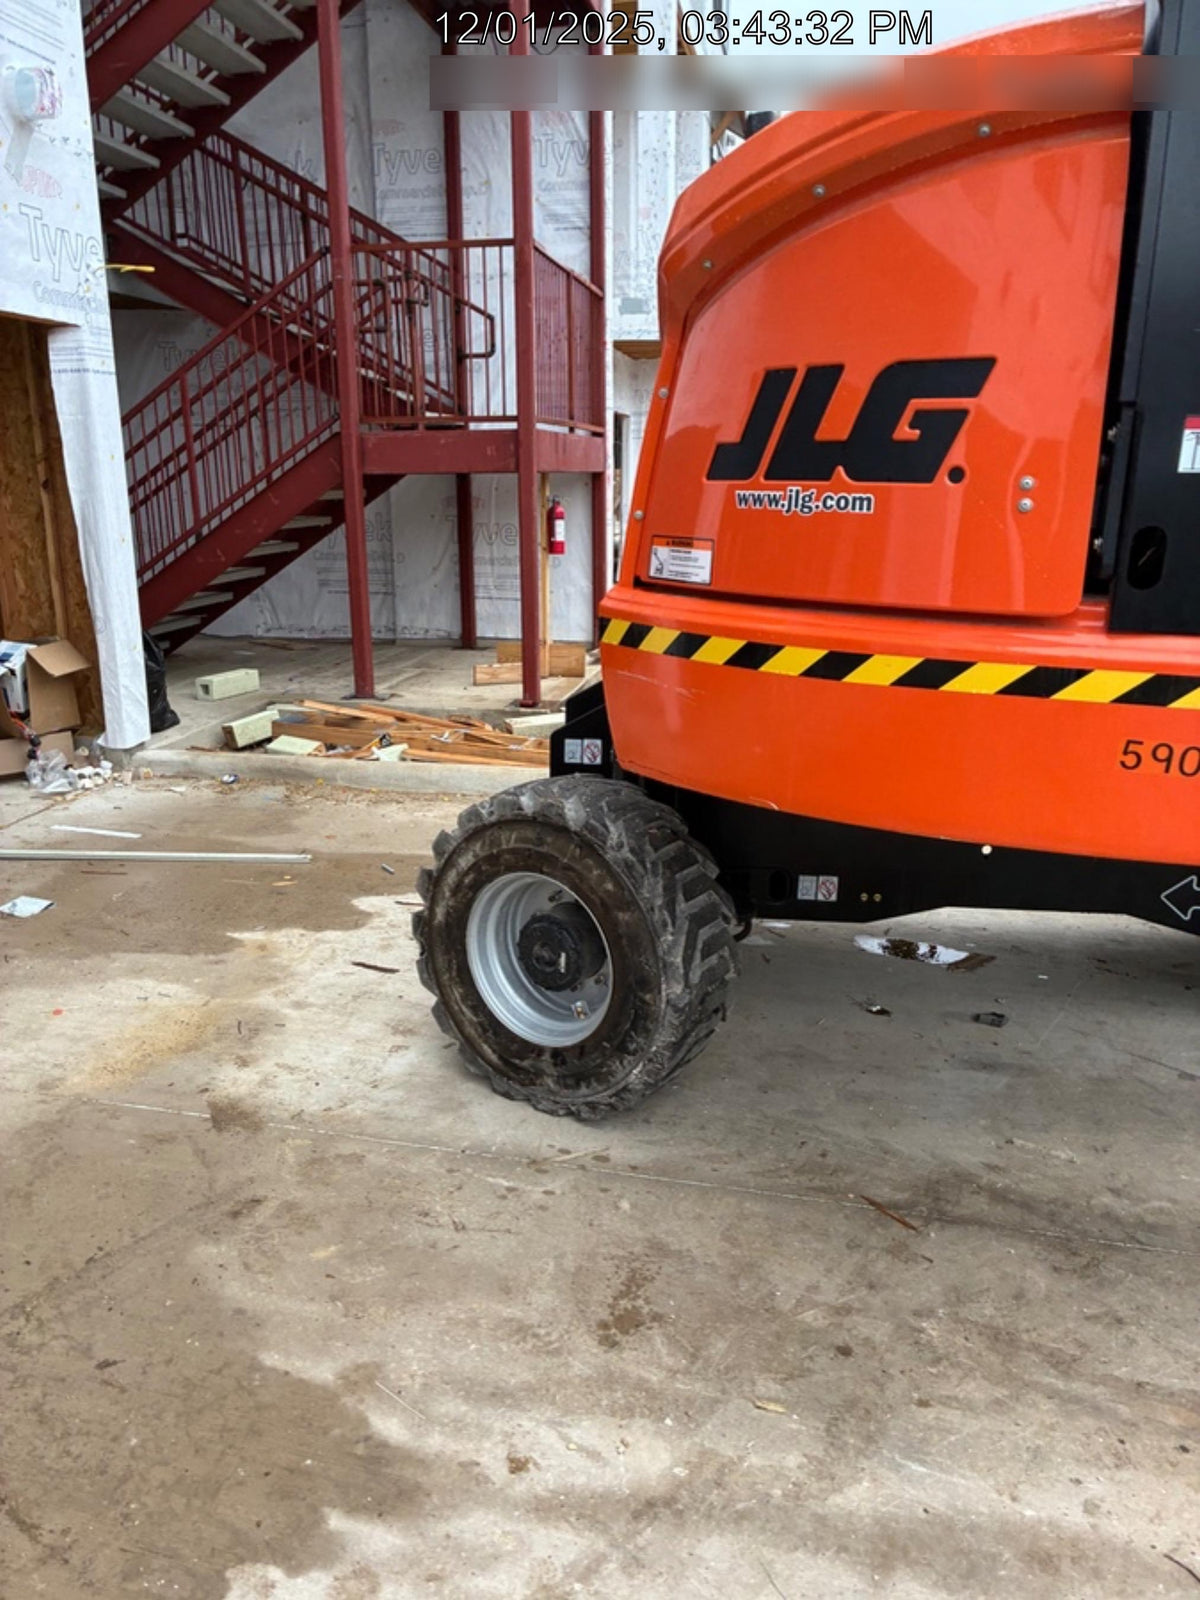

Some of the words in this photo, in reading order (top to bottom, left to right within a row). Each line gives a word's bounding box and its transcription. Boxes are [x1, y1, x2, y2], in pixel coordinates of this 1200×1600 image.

[370, 142, 442, 185] Tyve
[18, 202, 101, 283] Tyve
[736, 488, 873, 514] www.jlg.com
[1120, 739, 1200, 777] 590
